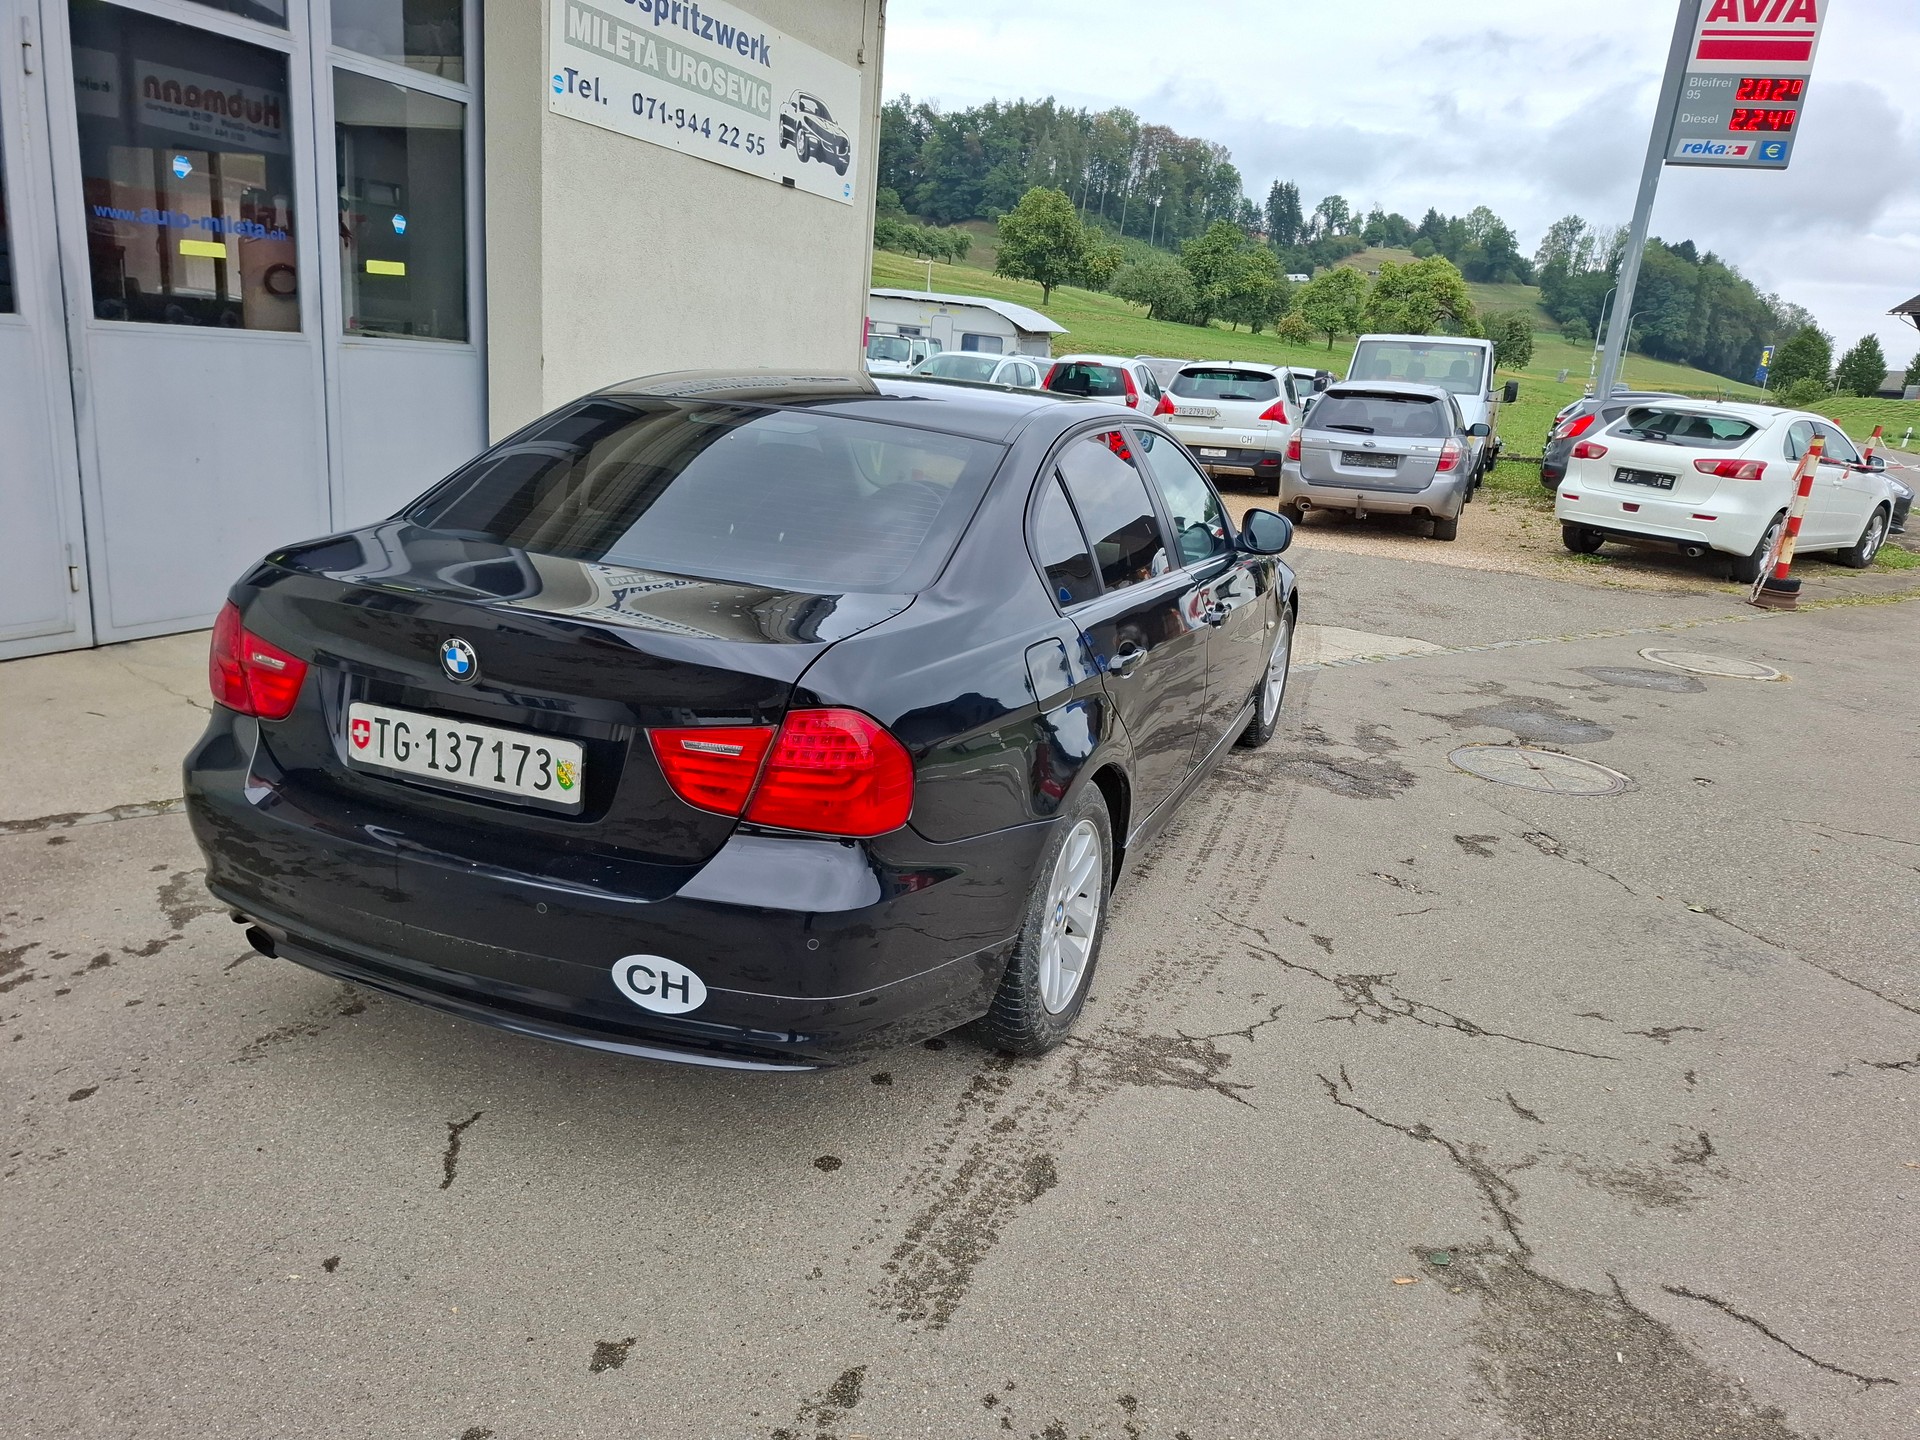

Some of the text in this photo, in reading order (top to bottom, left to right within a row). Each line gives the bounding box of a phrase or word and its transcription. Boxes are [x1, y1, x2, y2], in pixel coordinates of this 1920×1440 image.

[1705, 0, 1818, 23] AVIA
[569, 6, 770, 113] MILETA UROSEVIC
[1689, 77, 1733, 88] Bleifrei
[1686, 90, 1701, 100] 95
[564, 67, 608, 106] Tel.
[718, 122, 740, 149] 22
[746, 133, 765, 156] 55
[1681, 113, 1719, 124] Diesel
[93, 204, 287, 241] www.auto-mileta.ch
[1241, 435, 1253, 444] CH
[442, 640, 472, 656] BMW
[626, 964, 690, 1005] CH
